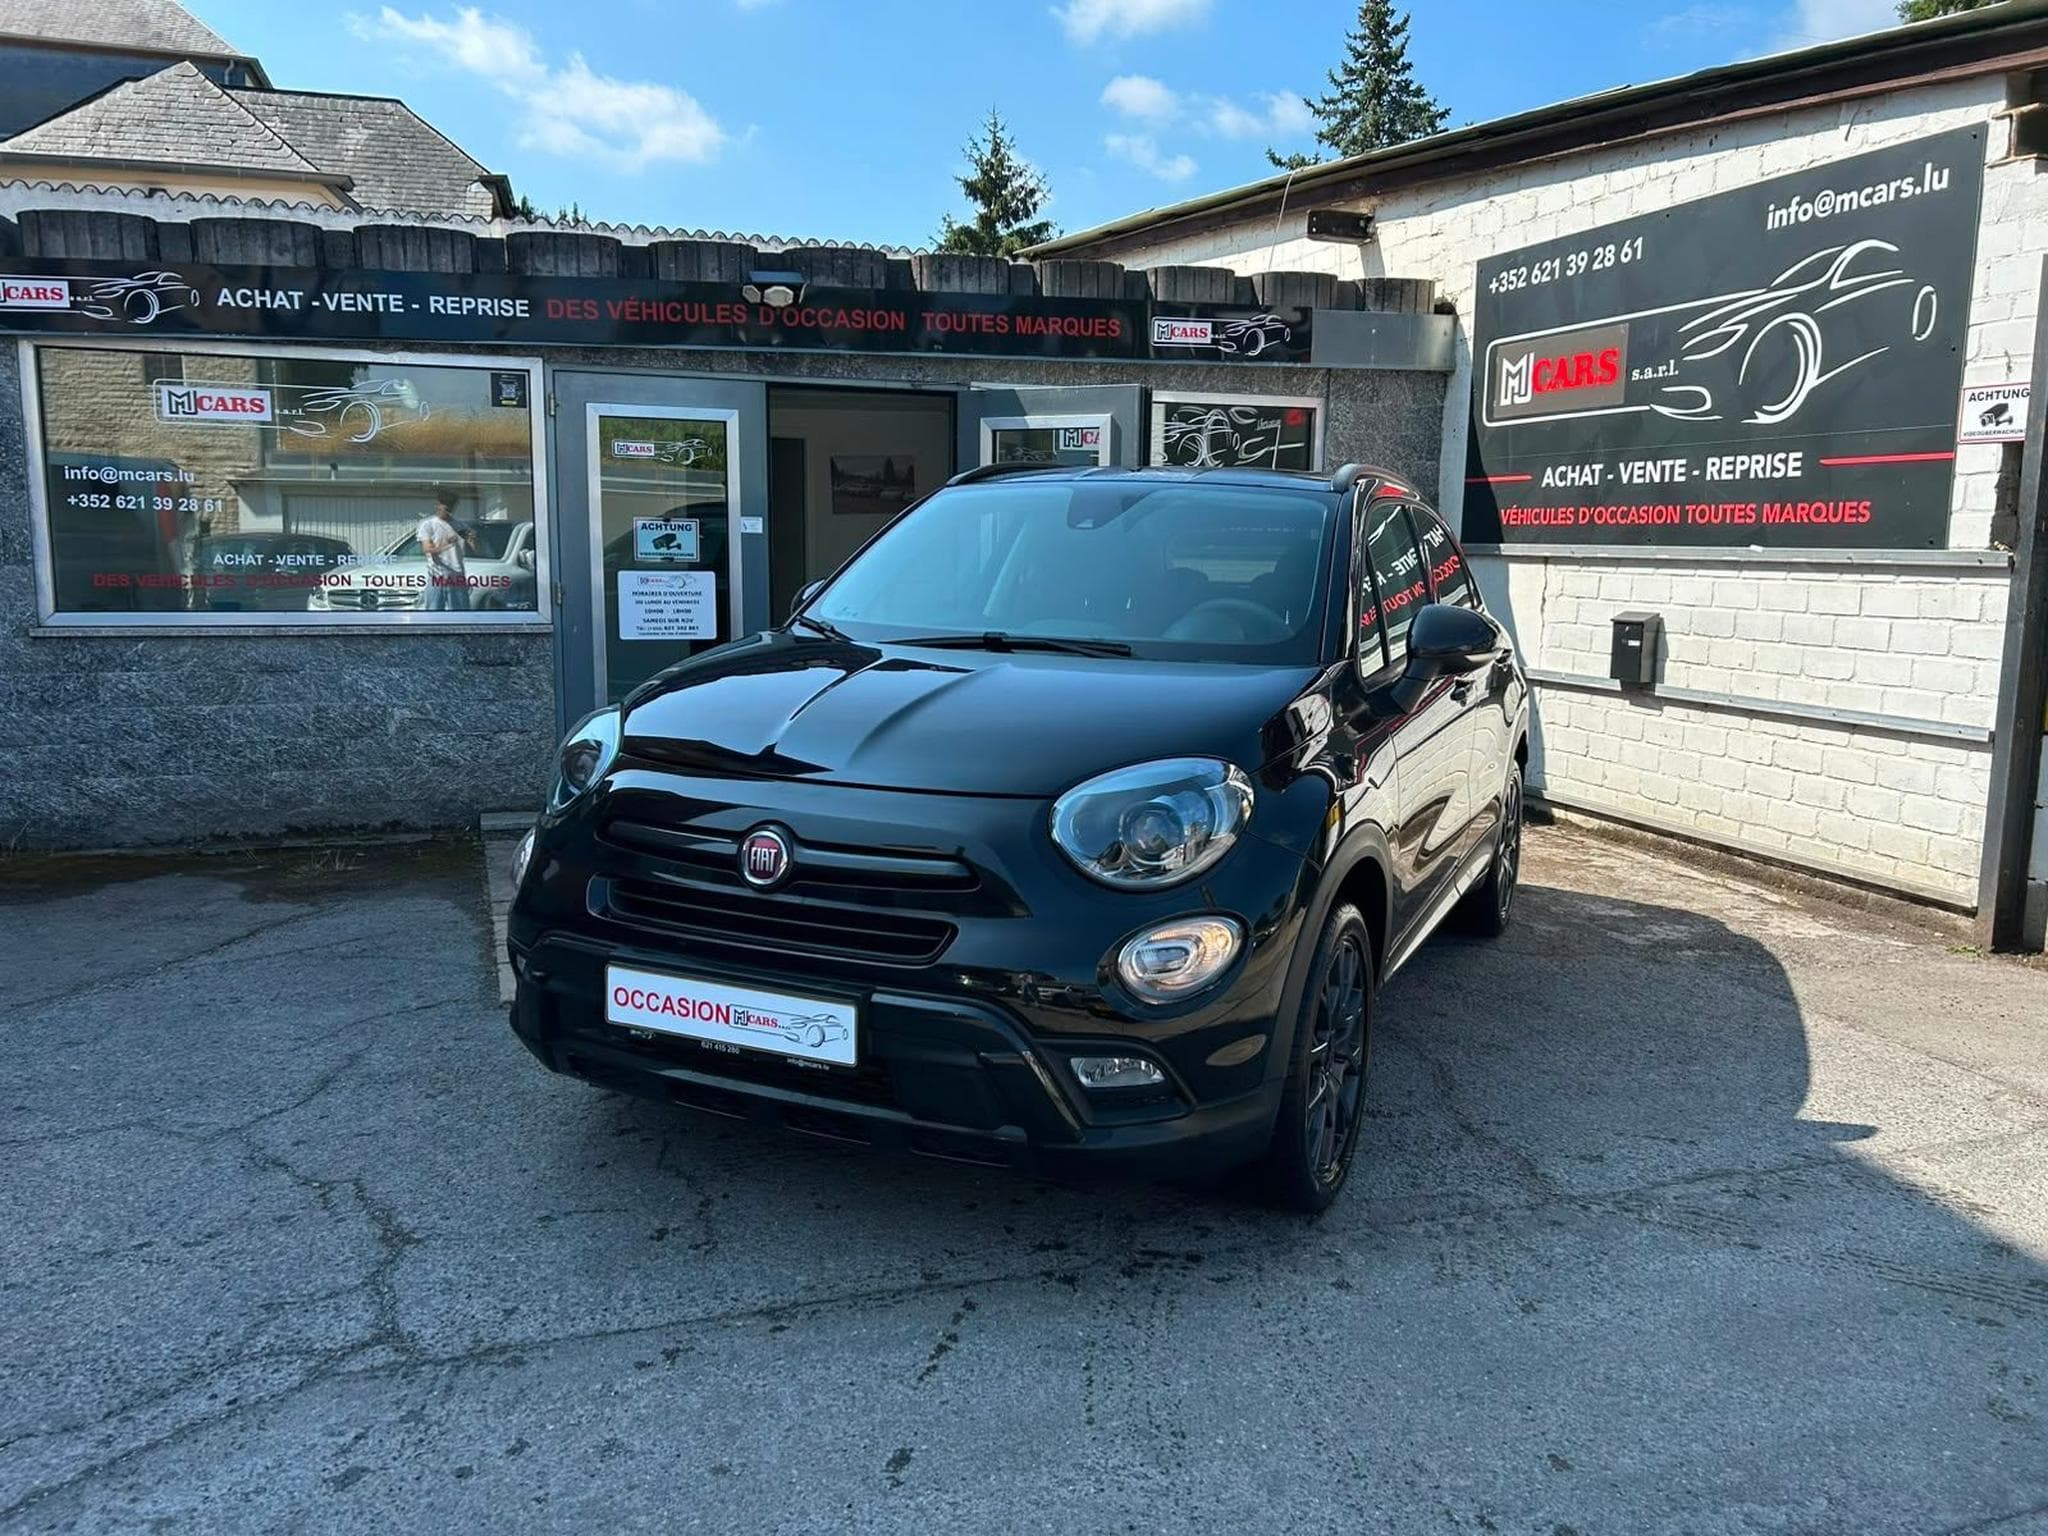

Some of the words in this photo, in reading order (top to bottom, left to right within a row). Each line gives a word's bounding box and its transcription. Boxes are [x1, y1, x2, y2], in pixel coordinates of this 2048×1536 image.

[1766, 161, 1950, 231] info@mcars.lu
[1488, 266, 1528, 294] +352
[1531, 257, 1561, 285] 621
[1566, 251, 1589, 277] 39
[1592, 244, 1616, 271] 28
[1620, 236, 1644, 264] 61
[216, 287, 304, 310] ACHAT
[429, 295, 530, 317] REPRISE
[546, 300, 599, 320] DES
[607, 297, 747, 324] VÉHICULES
[759, 306, 906, 331] D'OCCASION
[922, 312, 1010, 335] TOUTES
[1015, 314, 1122, 338] MARQUES
[1631, 359, 1680, 381] s.a.r.l.
[1968, 387, 2031, 402] ACHTUNG
[64, 466, 196, 485] info@mcars.lu
[1541, 463, 1604, 488] ACHAT
[1619, 458, 1687, 485] VENTE
[1705, 452, 1803, 481] REPRISE
[67, 494, 110, 509] +352
[115, 495, 146, 510] 621
[153, 496, 173, 511] 39
[178, 497, 199, 512] 28
[204, 498, 223, 513] 61
[1501, 504, 1576, 525] VÉHICULES
[1578, 505, 1681, 525] D'OCCASION
[1685, 502, 1758, 524] TOUTES
[1762, 501, 1872, 523] MARQUES
[640, 522, 693, 532] ACHTUNG
[213, 554, 264, 567] ACHAT
[277, 554, 325, 567] VENTE
[362, 574, 427, 588] TOUTES
[431, 574, 512, 588] MARQUES
[750, 846, 778, 873] FIAT
[614, 987, 730, 1025] OCCASION
